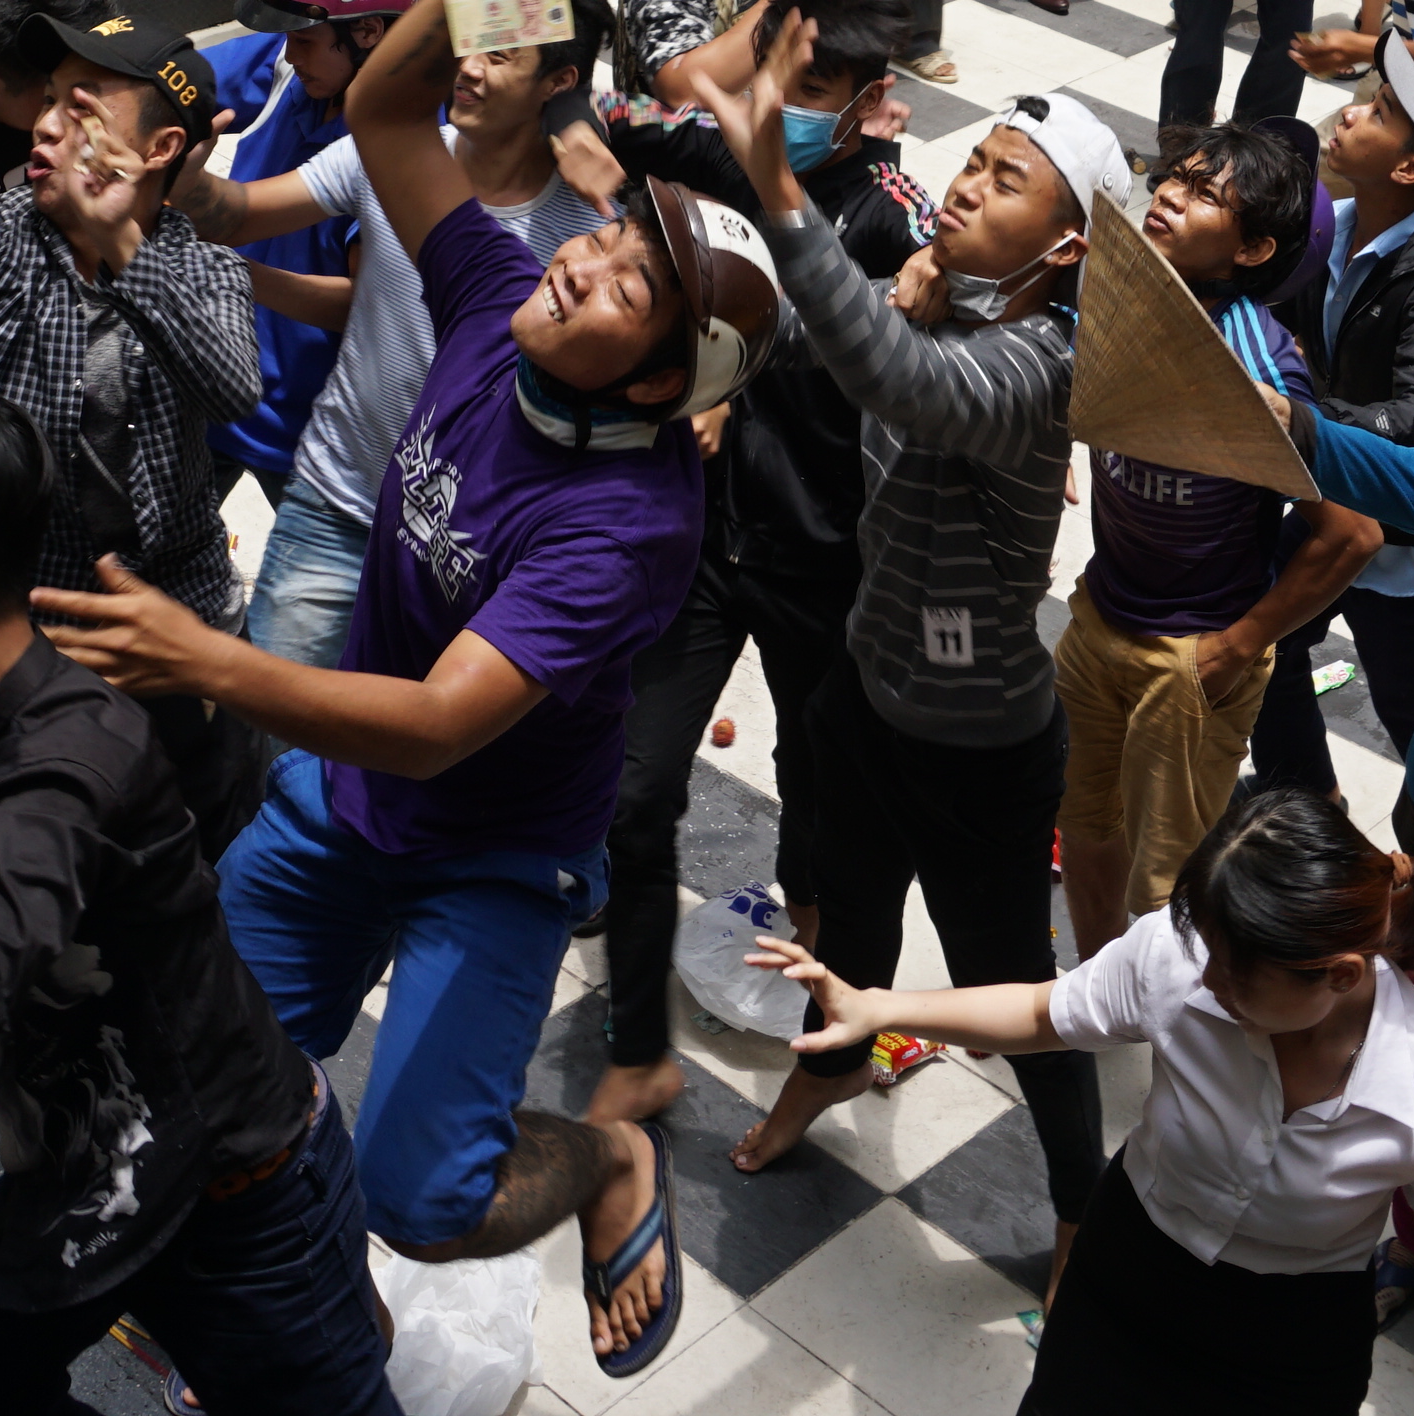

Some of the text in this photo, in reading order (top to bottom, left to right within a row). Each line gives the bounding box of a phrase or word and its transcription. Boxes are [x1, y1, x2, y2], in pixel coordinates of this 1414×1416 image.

[157, 61, 199, 106] 108
[1094, 447, 1195, 507] BALIFE
[934, 627, 964, 656] 11
